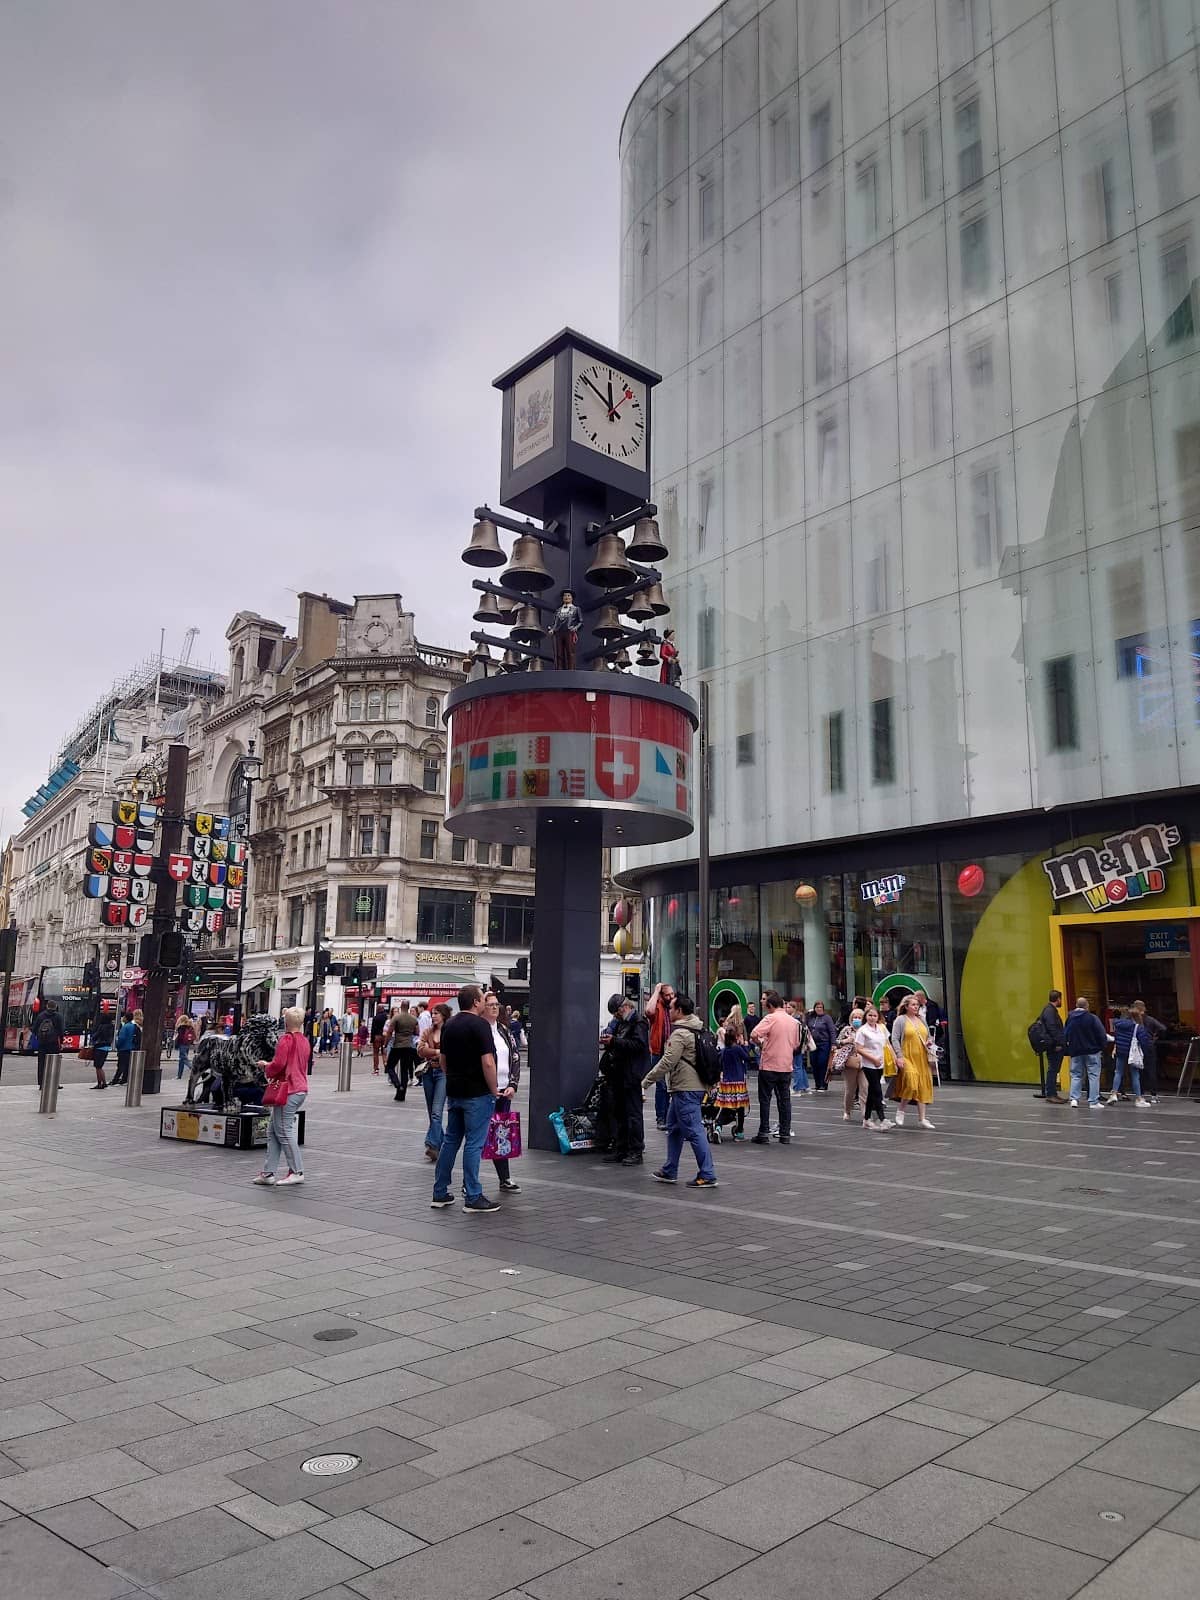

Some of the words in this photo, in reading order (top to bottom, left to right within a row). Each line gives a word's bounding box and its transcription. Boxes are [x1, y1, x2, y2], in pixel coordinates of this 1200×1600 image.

[1150, 931, 1169, 940] EXIT
[1149, 940, 1171, 948] ONLY
[415, 952, 446, 963] SHAKE
[447, 954, 478, 965] SHACK
